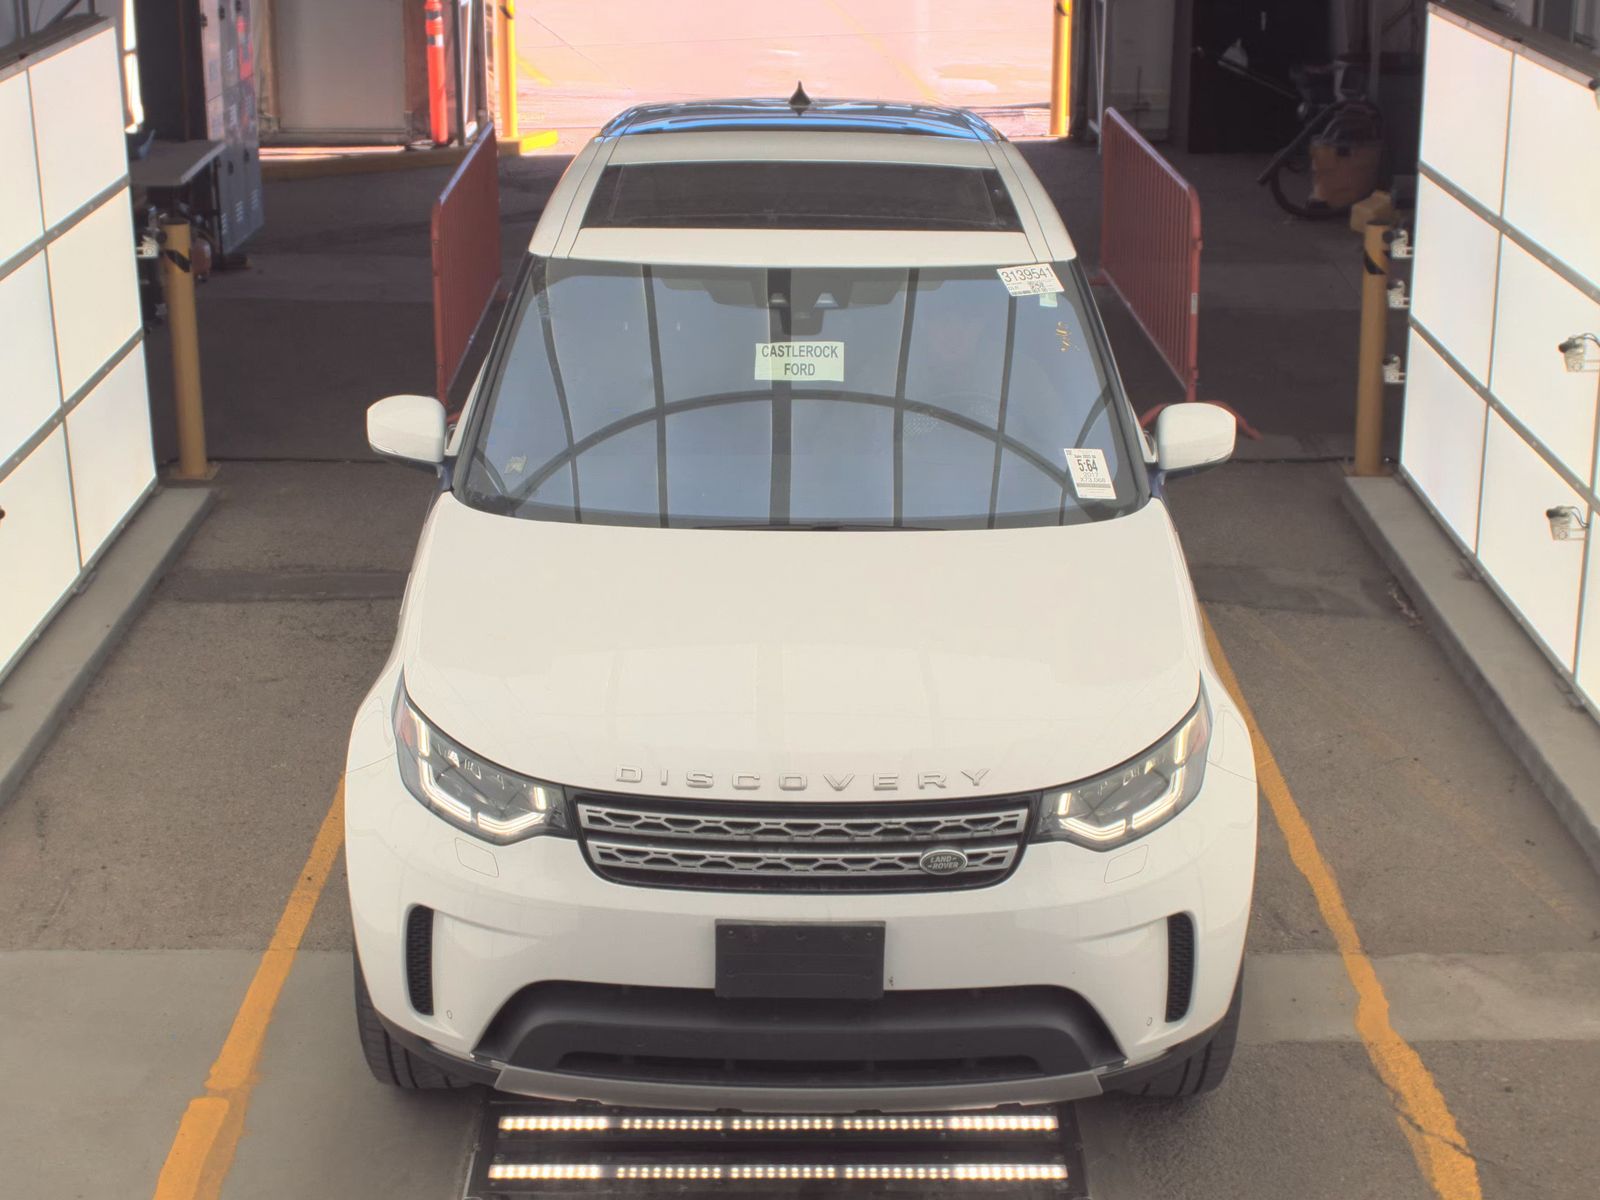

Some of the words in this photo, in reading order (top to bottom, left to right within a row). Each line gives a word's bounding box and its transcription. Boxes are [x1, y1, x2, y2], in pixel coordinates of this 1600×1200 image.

[1001, 266, 1054, 282] 3139541
[761, 345, 839, 358] CASTLEROCK
[784, 363, 816, 376] FORD
[614, 764, 991, 791] DISCOVERY
